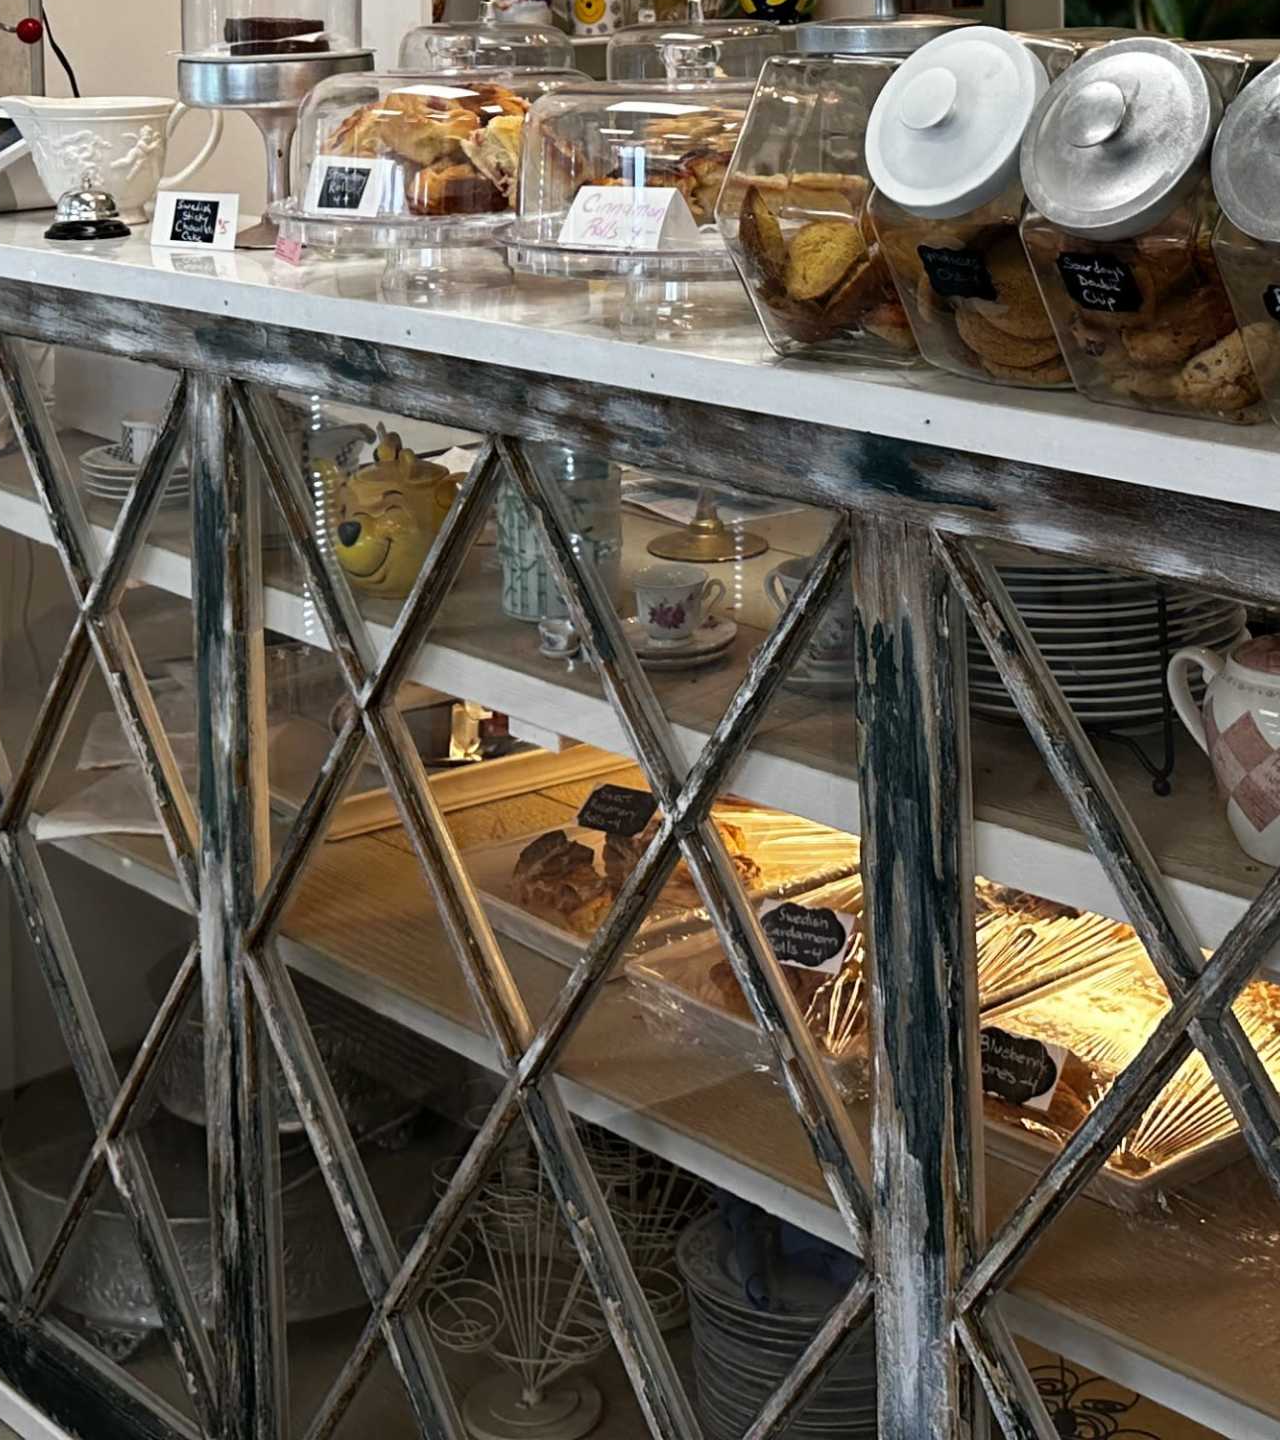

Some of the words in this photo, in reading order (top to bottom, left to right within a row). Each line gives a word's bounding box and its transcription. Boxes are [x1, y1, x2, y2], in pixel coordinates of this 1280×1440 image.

[780, 907, 829, 930] Swedish
[981, 1033, 1048, 1072] Blueberry
[981, 1063, 1017, 1085] ones
